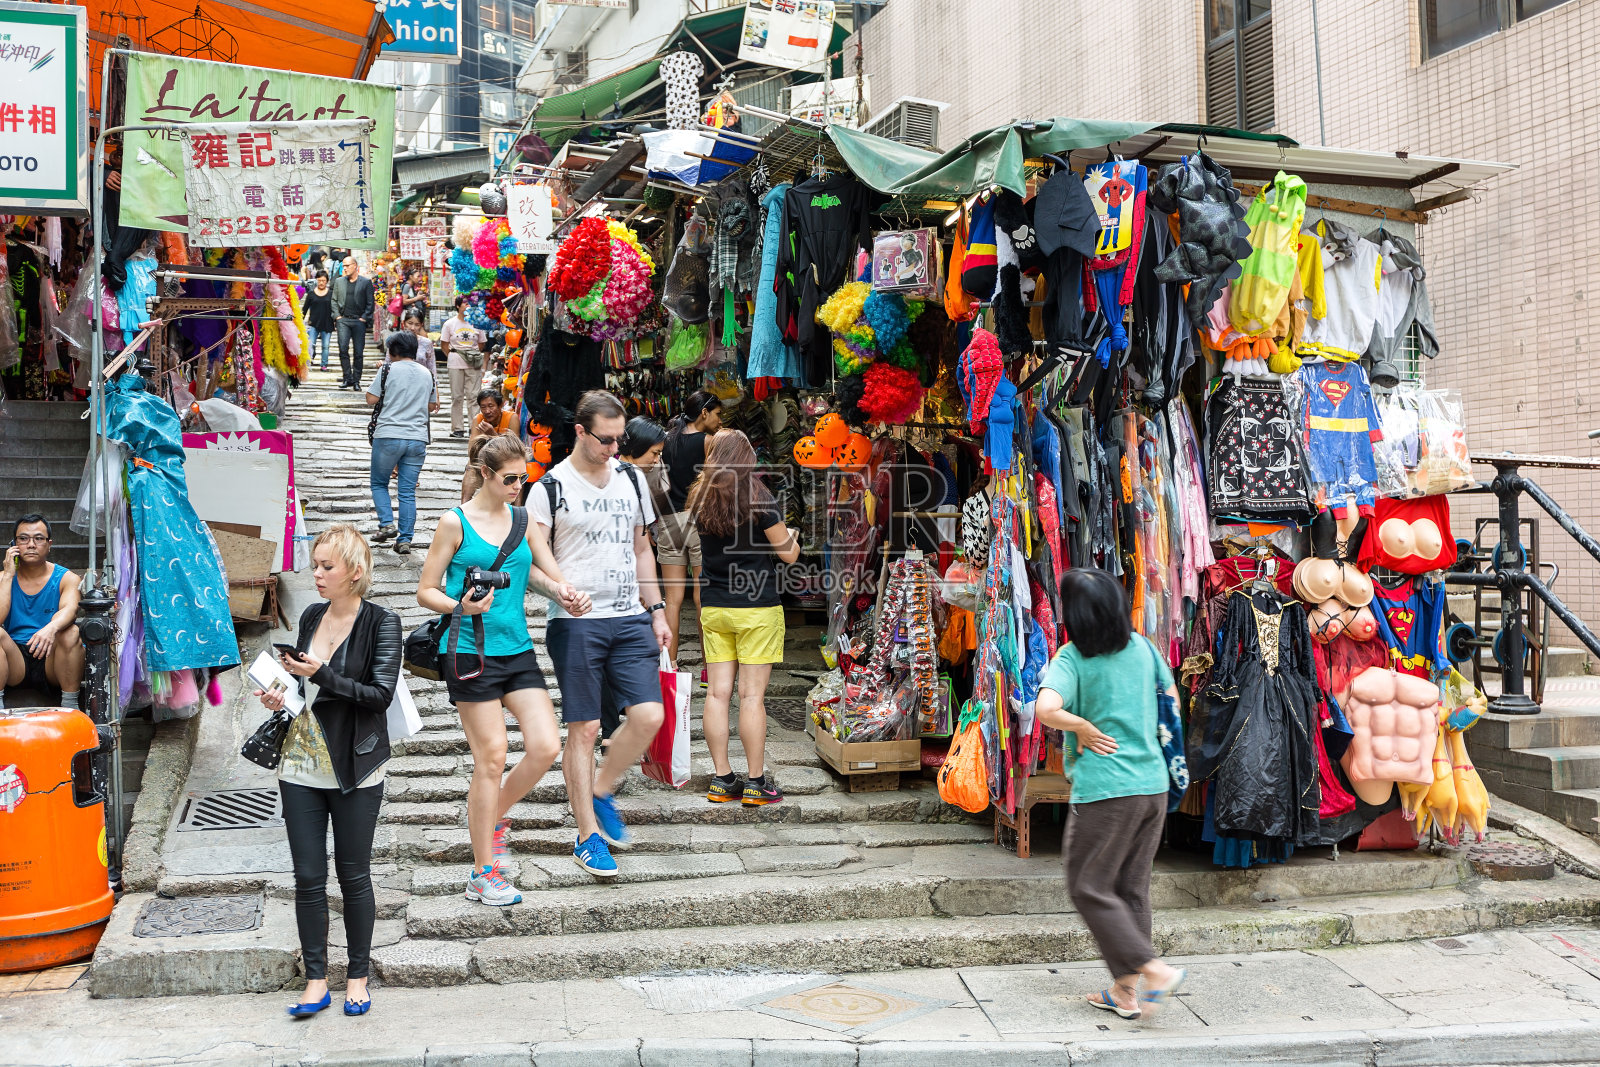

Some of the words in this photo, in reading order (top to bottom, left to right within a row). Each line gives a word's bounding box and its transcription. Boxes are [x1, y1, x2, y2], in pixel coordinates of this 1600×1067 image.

[389, 19, 455, 43] hion
[0, 102, 56, 134] 件相
[279, 147, 336, 166] 跳舞鞋
[242, 184, 305, 209] 電話
[199, 210, 342, 236] 25258753
